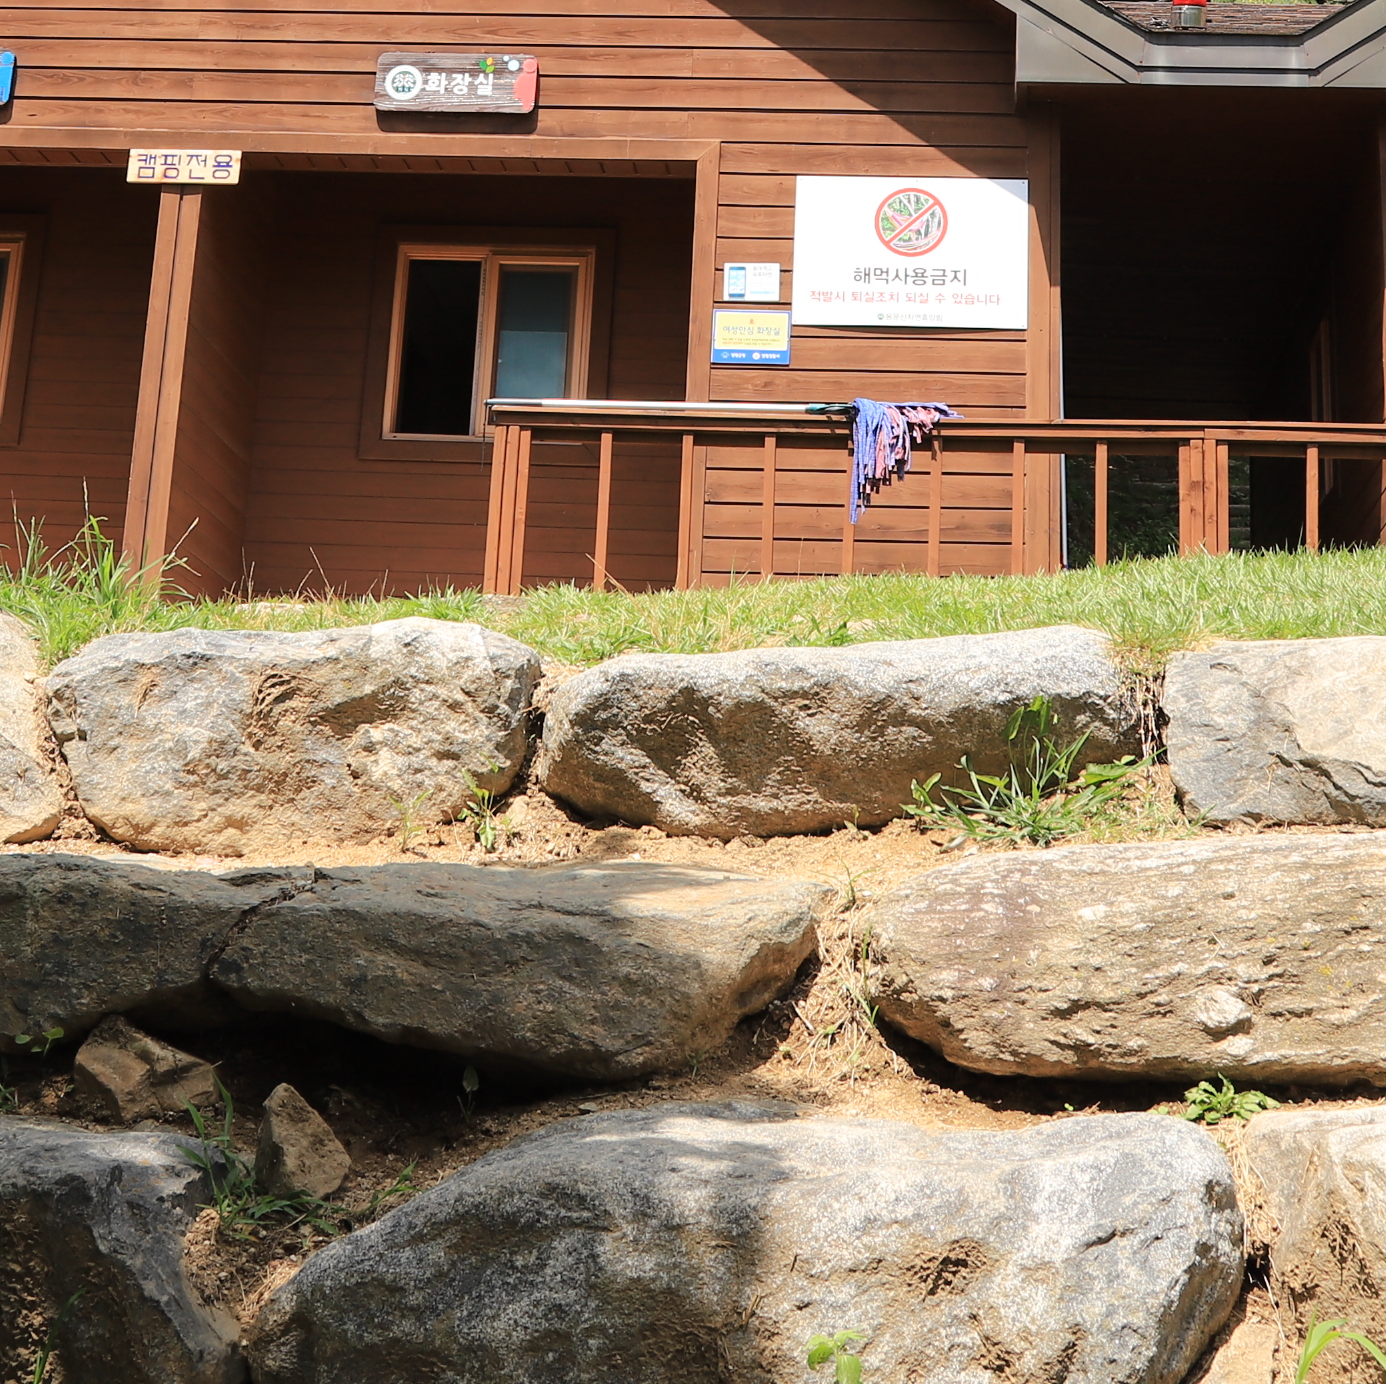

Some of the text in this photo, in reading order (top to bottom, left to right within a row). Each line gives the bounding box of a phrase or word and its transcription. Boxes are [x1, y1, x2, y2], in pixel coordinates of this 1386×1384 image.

[425, 72, 494, 96] 화장실
[137, 154, 233, 180] 캠핑전용
[853, 267, 967, 286] 해먹사용금지
[809, 290, 1001, 305] 적발시 퇴실조치 되실 수 있습니다
